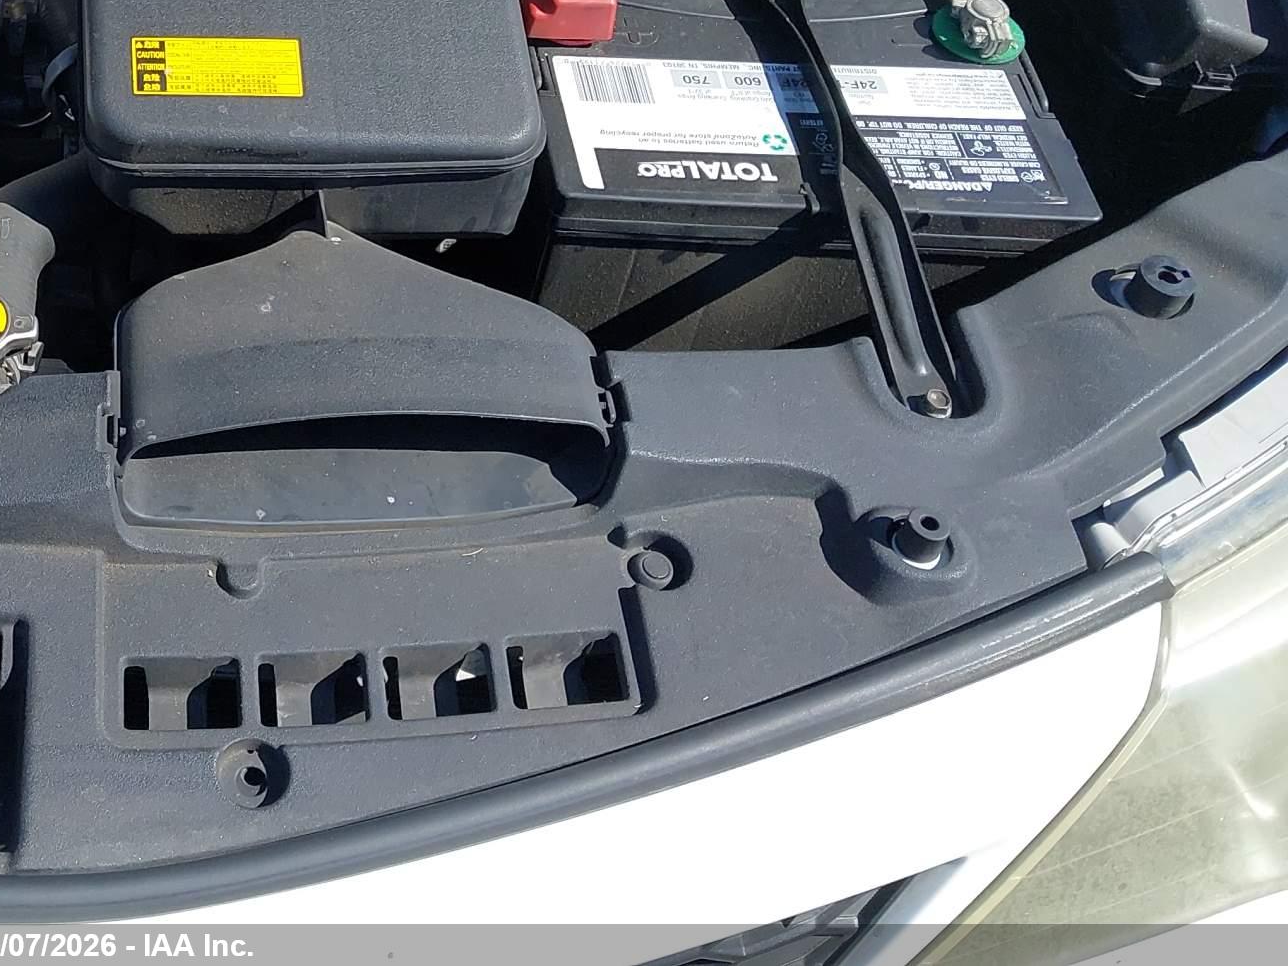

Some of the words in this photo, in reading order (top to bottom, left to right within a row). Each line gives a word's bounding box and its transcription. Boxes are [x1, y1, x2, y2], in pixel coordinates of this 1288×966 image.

[137, 51, 165, 59] CAUTION
[137, 63, 165, 71] ATTENTION
[682, 74, 710, 85] 750
[734, 76, 761, 86] 600
[637, 160, 778, 182] TOTALPRO
